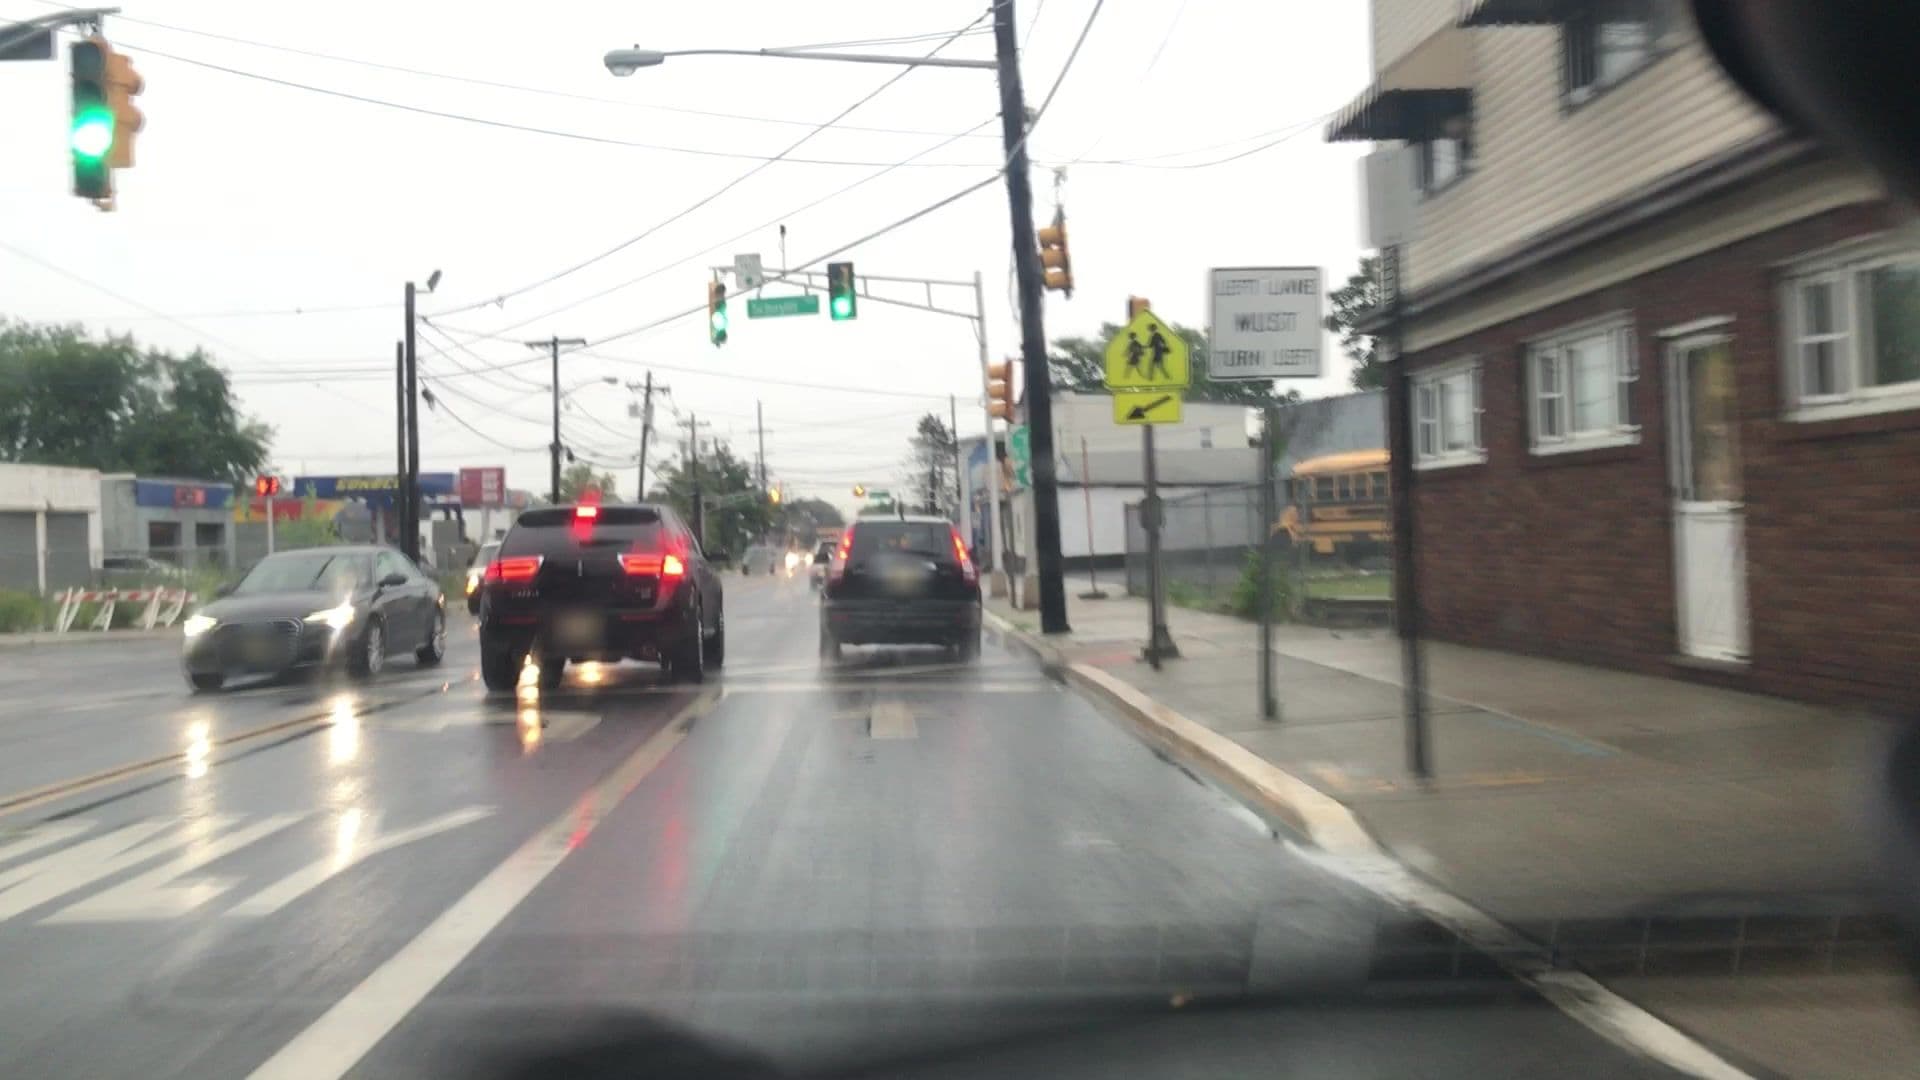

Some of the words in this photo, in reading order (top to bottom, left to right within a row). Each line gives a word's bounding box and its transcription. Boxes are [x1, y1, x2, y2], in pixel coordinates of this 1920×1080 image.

[1214, 279, 1260, 296] LEFT
[1267, 278, 1317, 296] LANE
[1234, 312, 1298, 333] MUST
[1213, 350, 1261, 368] TURN
[1272, 348, 1317, 366] LEFT
